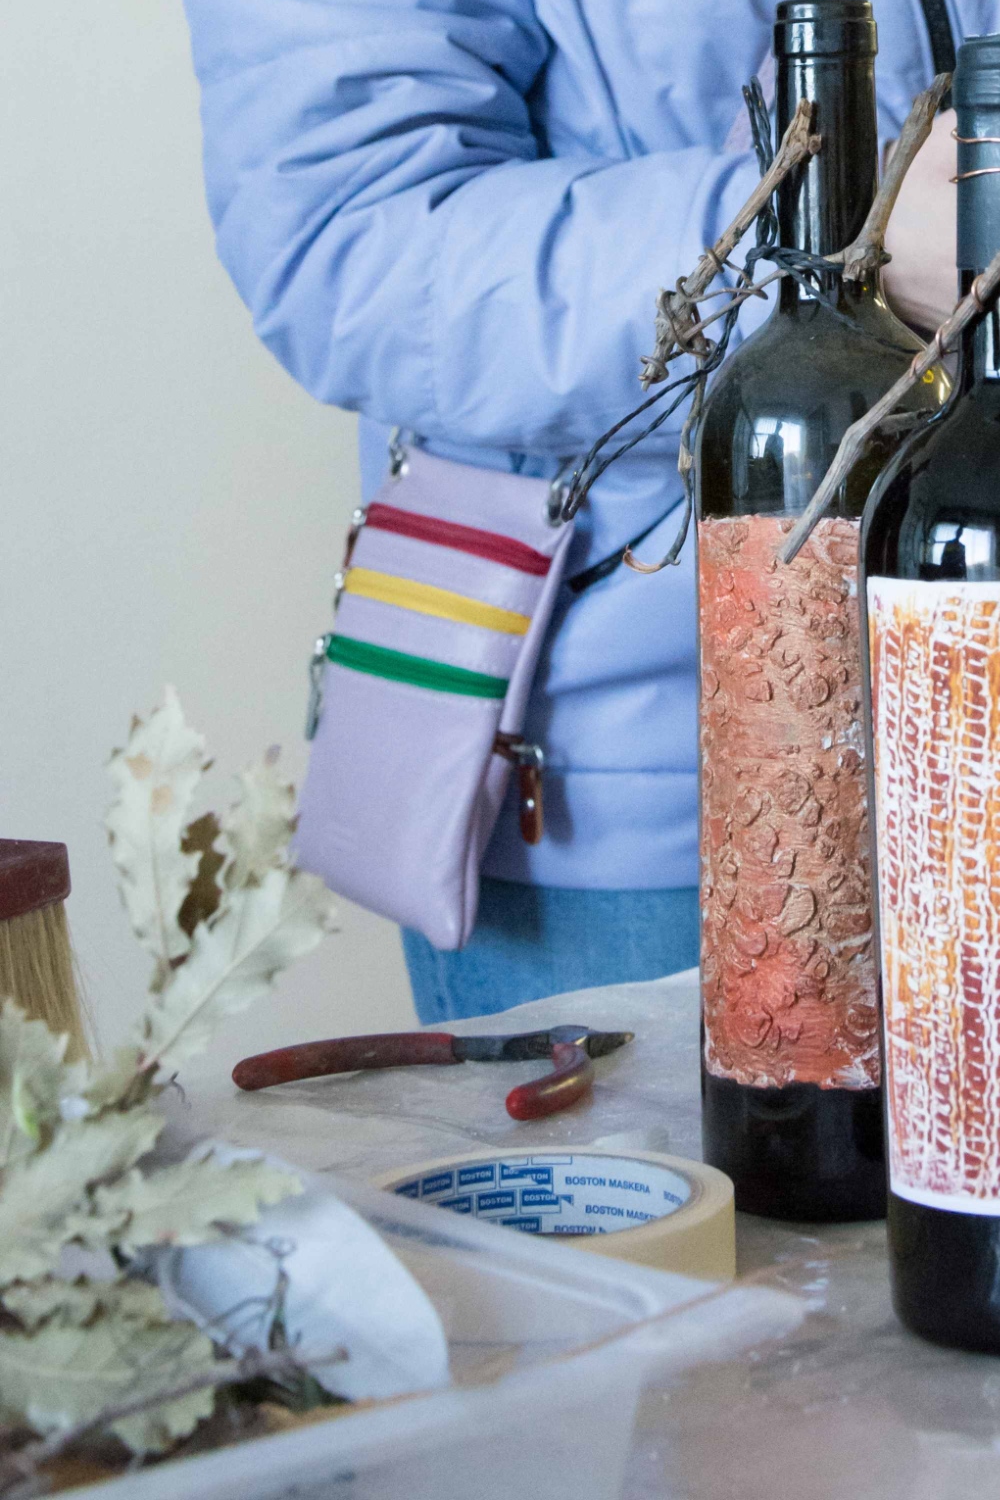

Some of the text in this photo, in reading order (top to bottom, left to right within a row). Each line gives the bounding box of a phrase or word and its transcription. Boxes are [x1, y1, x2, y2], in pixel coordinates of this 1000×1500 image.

[460, 1171, 492, 1182] BOSTON
[565, 1176, 650, 1194] BOSTON MASKERA
[481, 1196, 513, 1207] BOSTON
[524, 1193, 557, 1202] BOSTON
[585, 1204, 624, 1217] BOSTON
[554, 1225, 596, 1234] BOSTON
